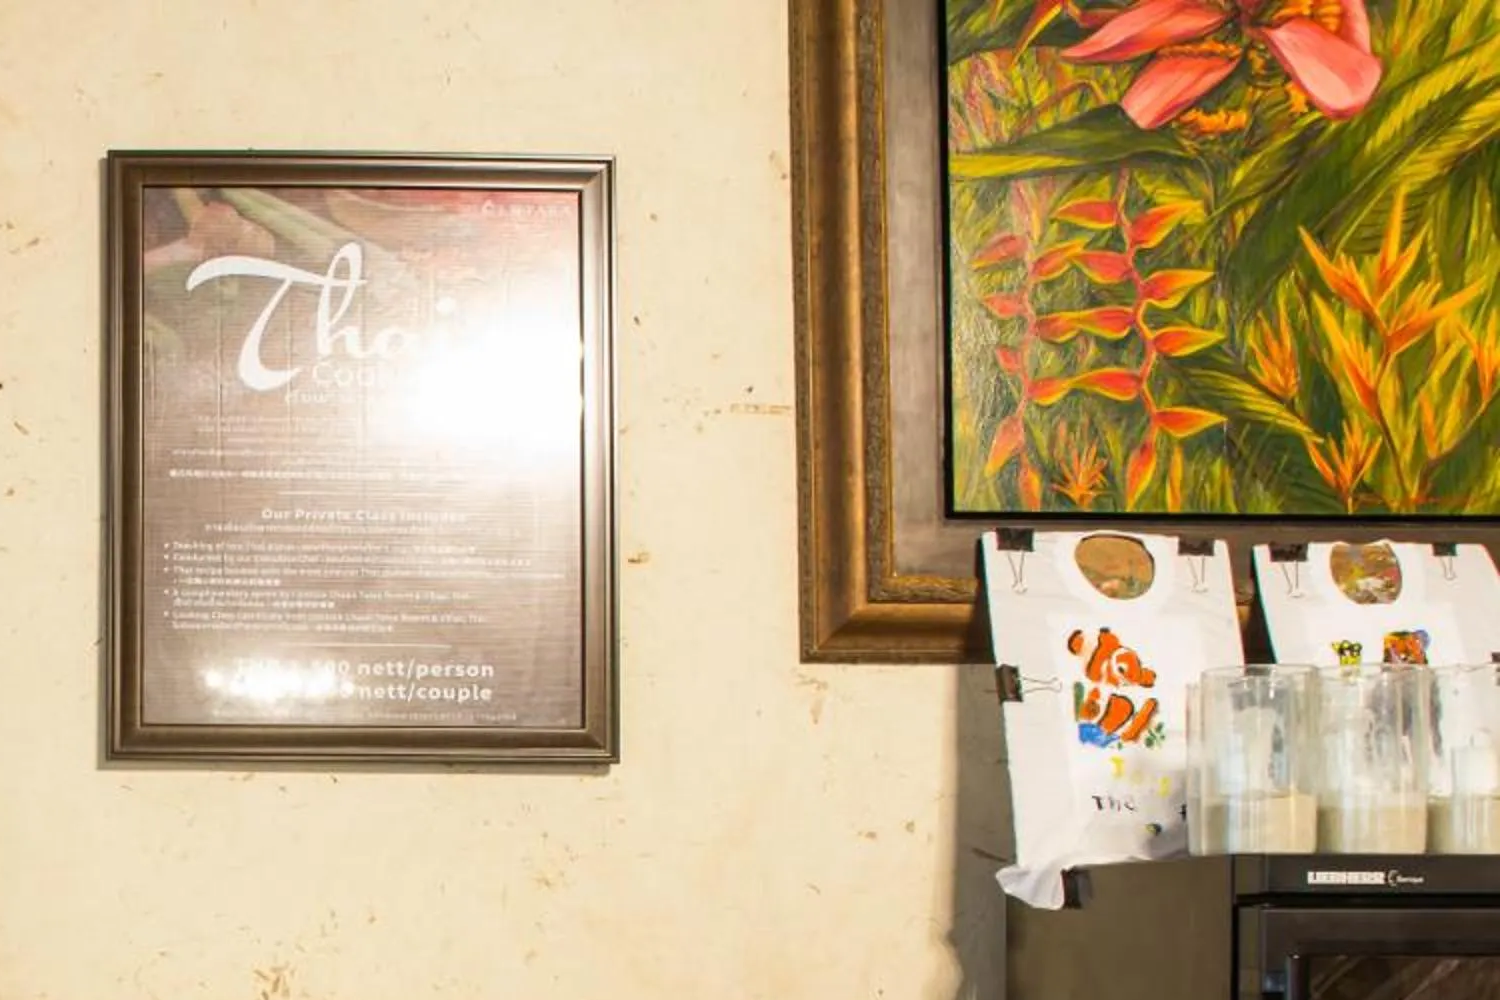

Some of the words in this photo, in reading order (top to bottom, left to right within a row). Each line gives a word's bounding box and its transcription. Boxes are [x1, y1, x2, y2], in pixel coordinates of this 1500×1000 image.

[261, 508, 294, 520] Our
[357, 658, 495, 680] nett/person
[358, 682, 493, 703] nett/couple
